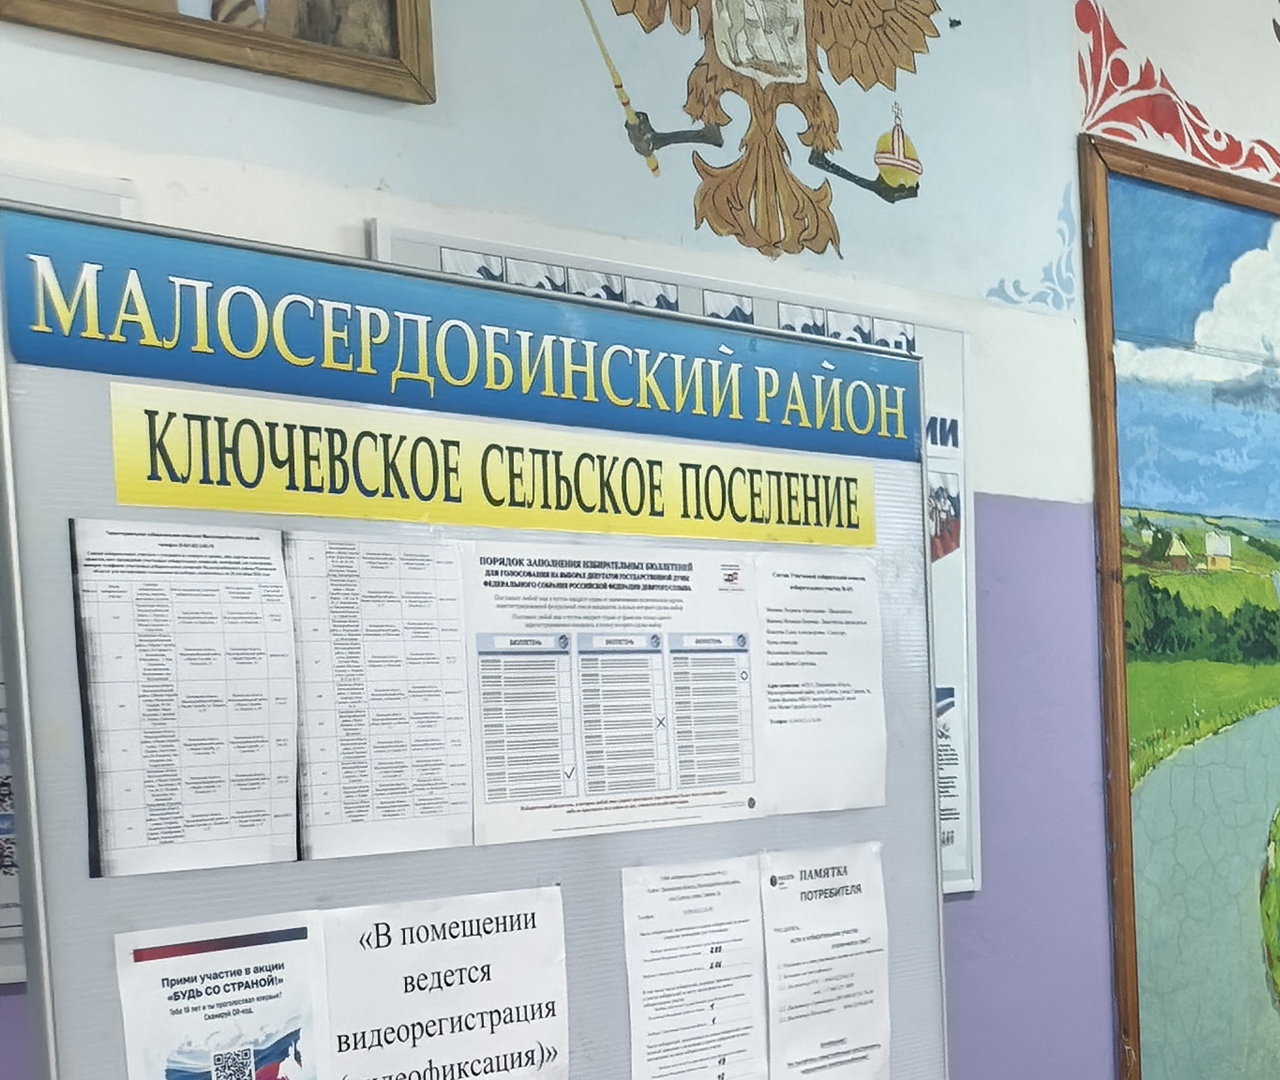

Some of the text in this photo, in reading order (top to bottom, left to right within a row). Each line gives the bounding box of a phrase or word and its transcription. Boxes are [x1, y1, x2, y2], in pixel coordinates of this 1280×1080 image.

[26, 253, 910, 441] МАЛОСЕРДОБИНСКИЙ РАЙОН
[144, 409, 861, 531] КЛЮЧЕВСКОЕ СЕЛЬСКОЕ ПОСЕЛЕНИЕ
[479, 556, 525, 567] ПОРЯДОК
[526, 558, 581, 569] ЗАПОЛНЕНИЯ
[800, 866, 848, 881] ПАМЯТКА
[800, 883, 862, 902] ПОТРЕБИТЕЛЯ
[358, 911, 537, 950] «В помещении
[161, 962, 285, 988] Прими участие в акции
[167, 975, 284, 1002] «БУДЬ СО СТРАНОЙ!»
[403, 963, 492, 993] ведется
[337, 1000, 557, 1053] видеорегистрация
